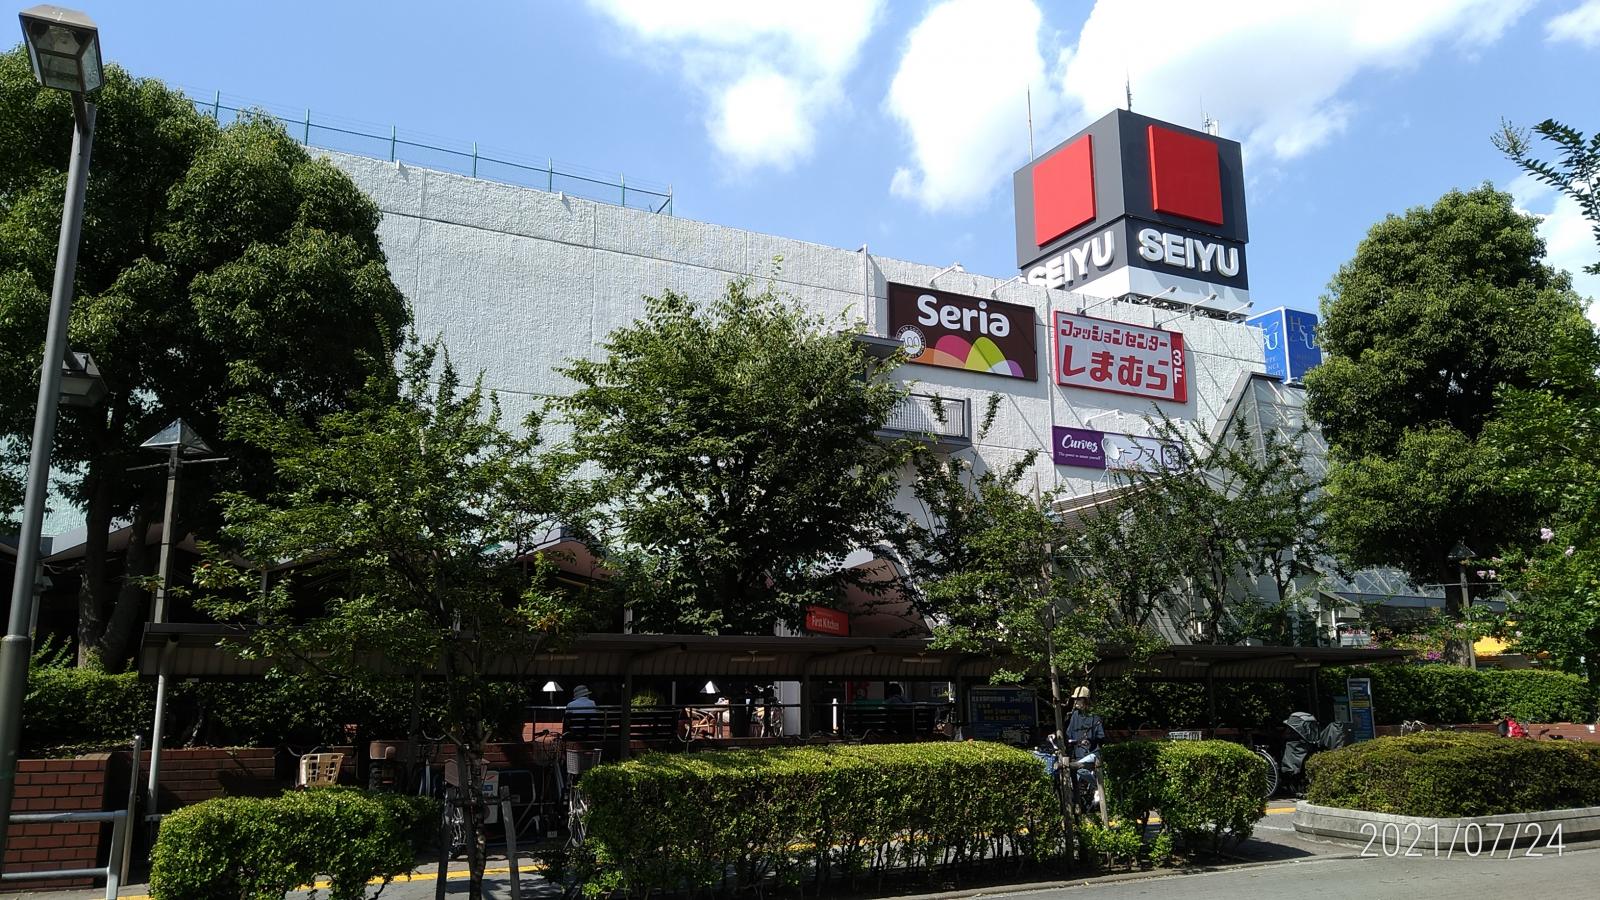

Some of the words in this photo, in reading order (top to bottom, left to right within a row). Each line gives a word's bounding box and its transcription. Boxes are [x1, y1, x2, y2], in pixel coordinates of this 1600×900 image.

[1027, 231, 1115, 289] SEIYU
[1138, 228, 1240, 278] SEIYU
[917, 294, 1010, 337] Seria
[1061, 320, 1168, 351] ファッションセンター
[1062, 344, 1169, 391] しまむら
[1172, 350, 1183, 384] 3F
[1061, 434, 1098, 453] Curves
